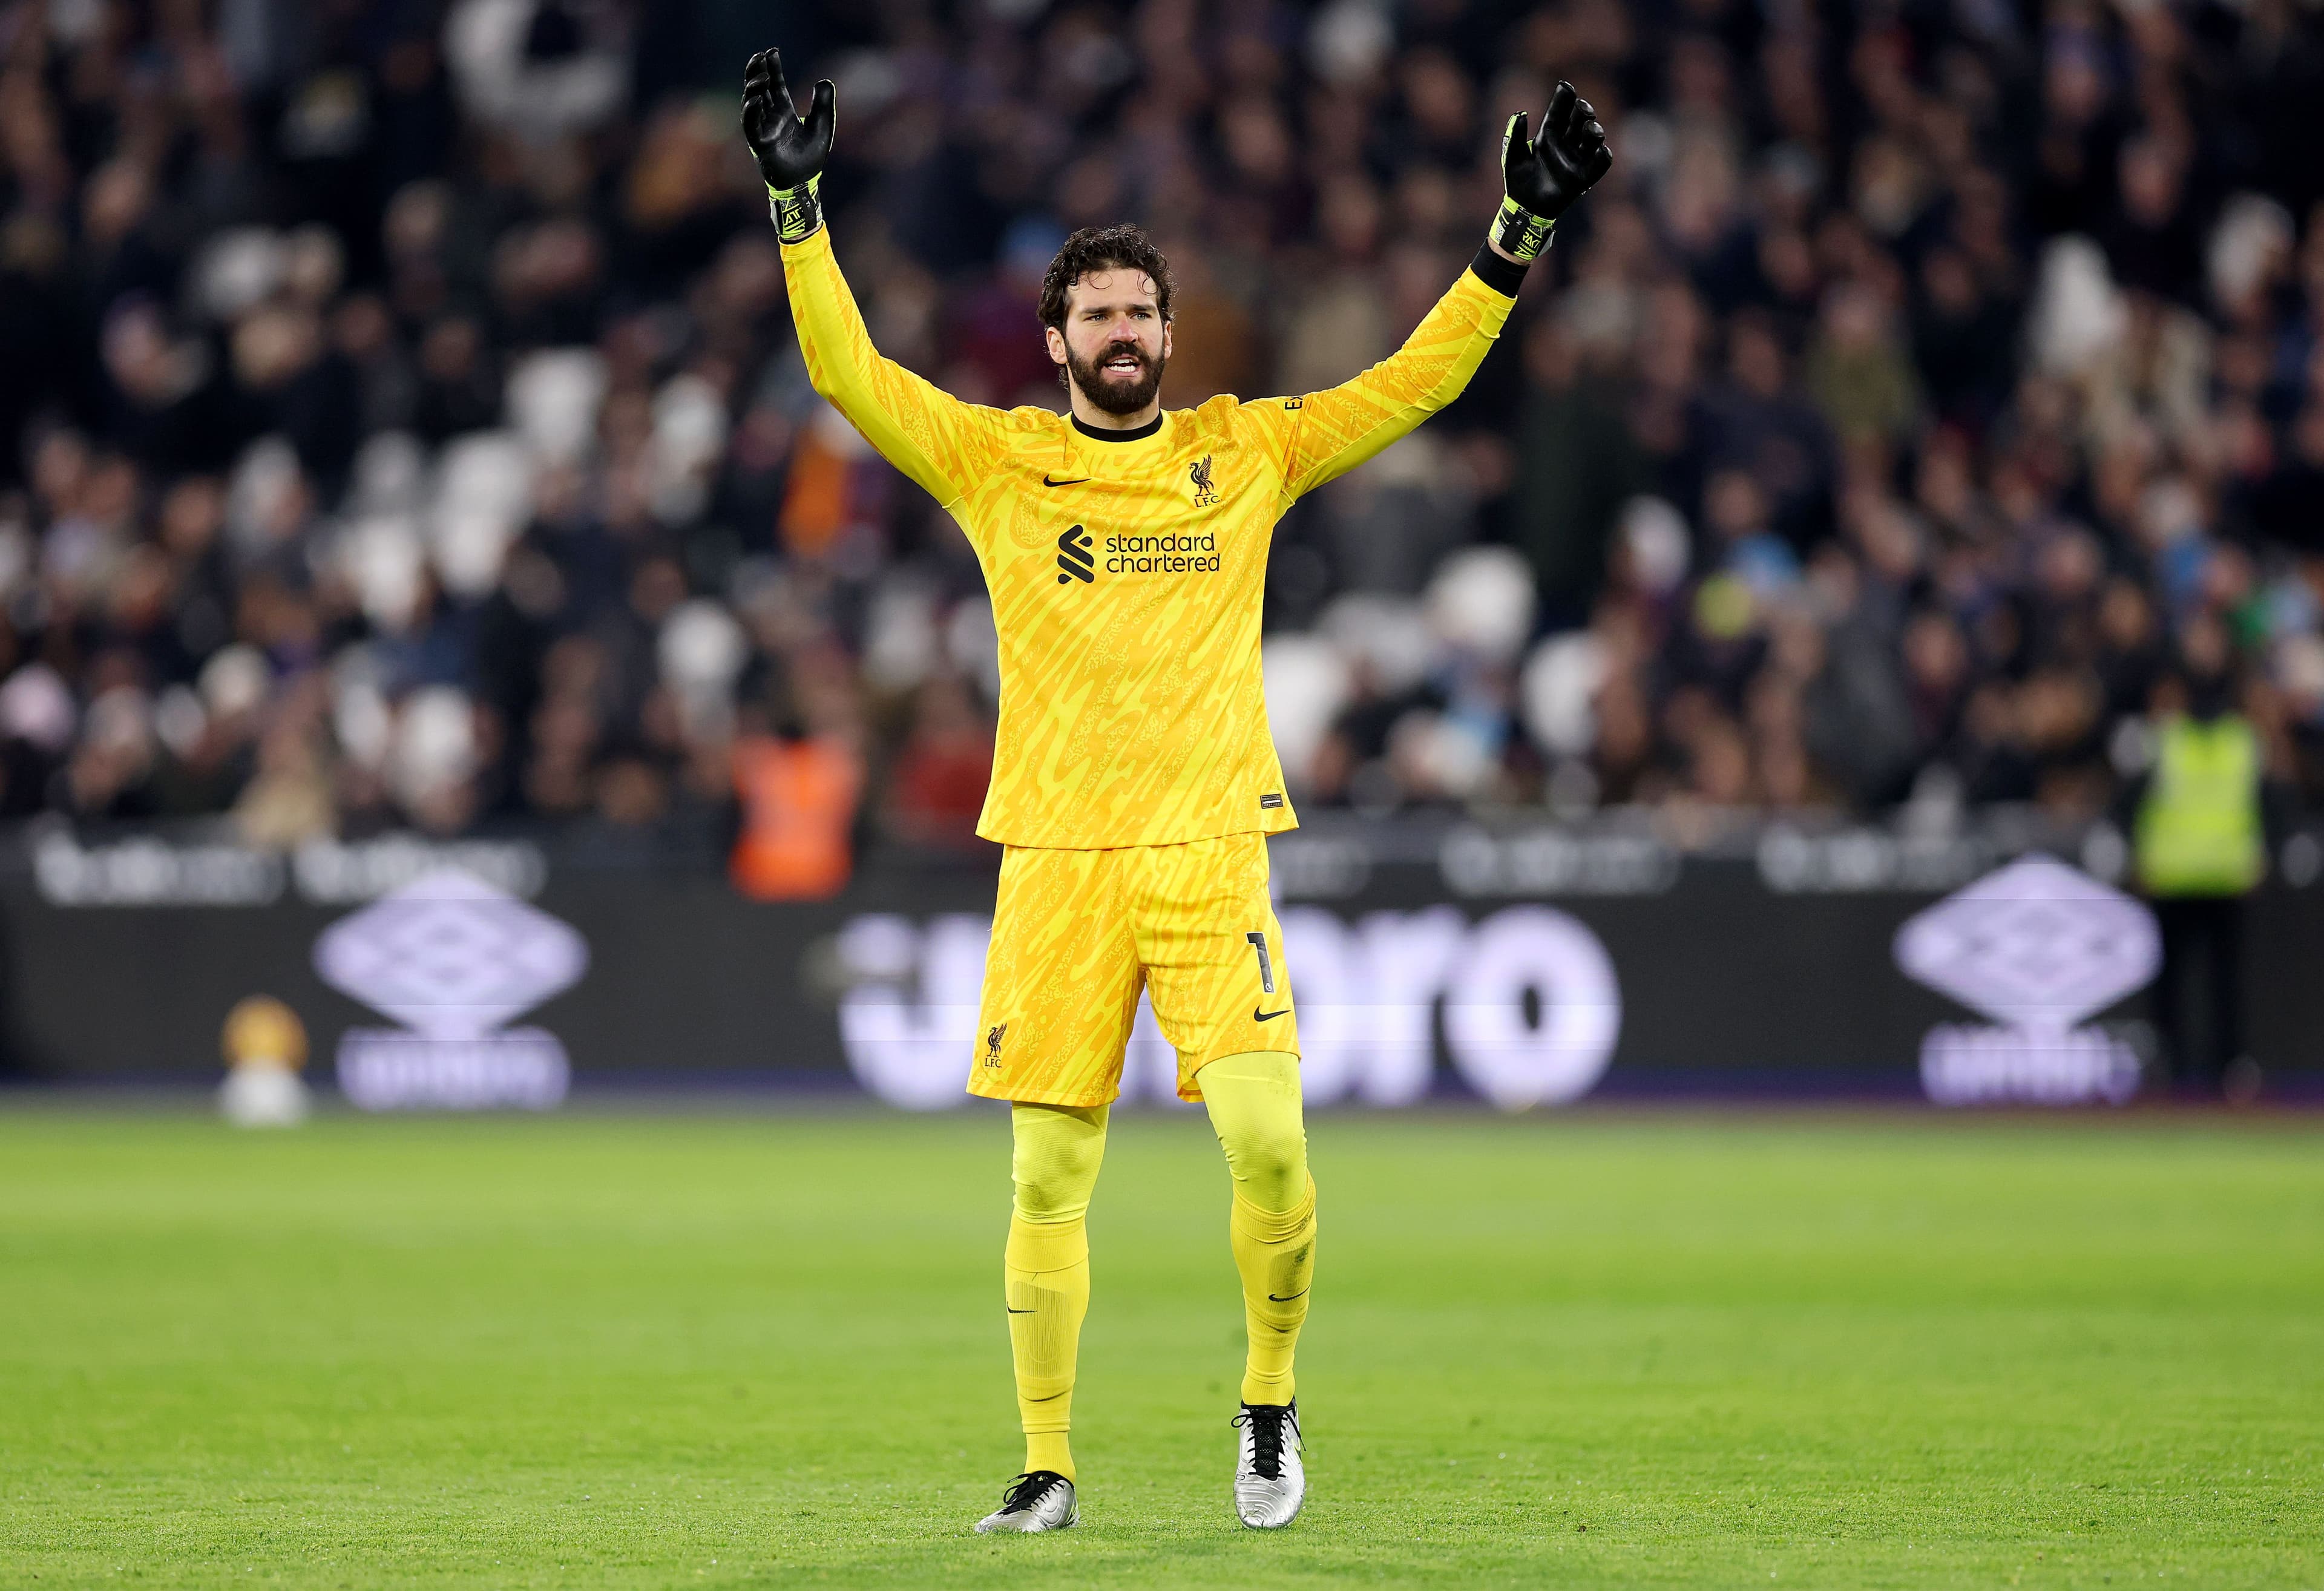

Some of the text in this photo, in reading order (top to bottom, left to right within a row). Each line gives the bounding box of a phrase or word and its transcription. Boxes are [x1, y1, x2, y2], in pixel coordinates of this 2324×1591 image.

[1106, 533, 1215, 553] standard
[1106, 553, 1220, 573] chartered
[1246, 932, 1275, 993] 1
